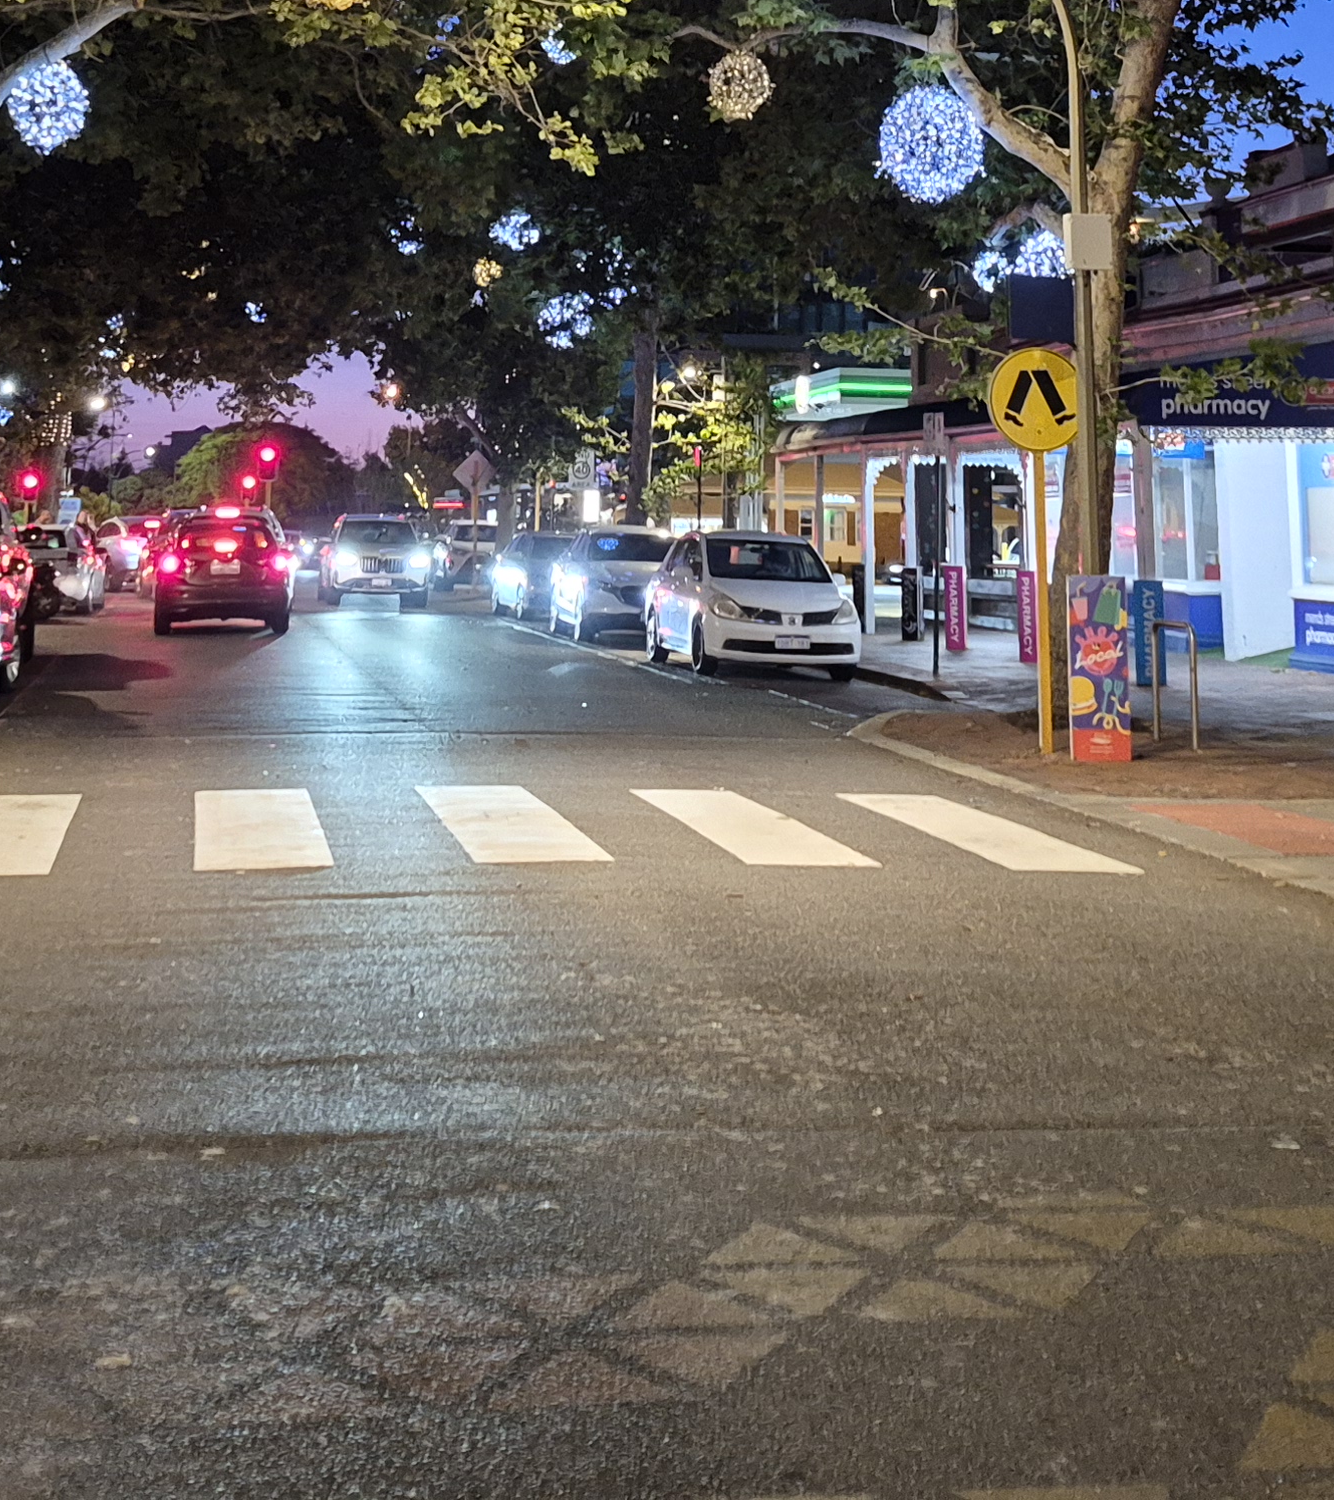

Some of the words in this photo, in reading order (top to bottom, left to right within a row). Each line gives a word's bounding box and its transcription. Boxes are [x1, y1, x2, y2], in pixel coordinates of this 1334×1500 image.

[1160, 396, 1271, 421] pharmacy
[948, 571, 960, 643] PHARMACY
[1021, 576, 1033, 655] PHARMACY
